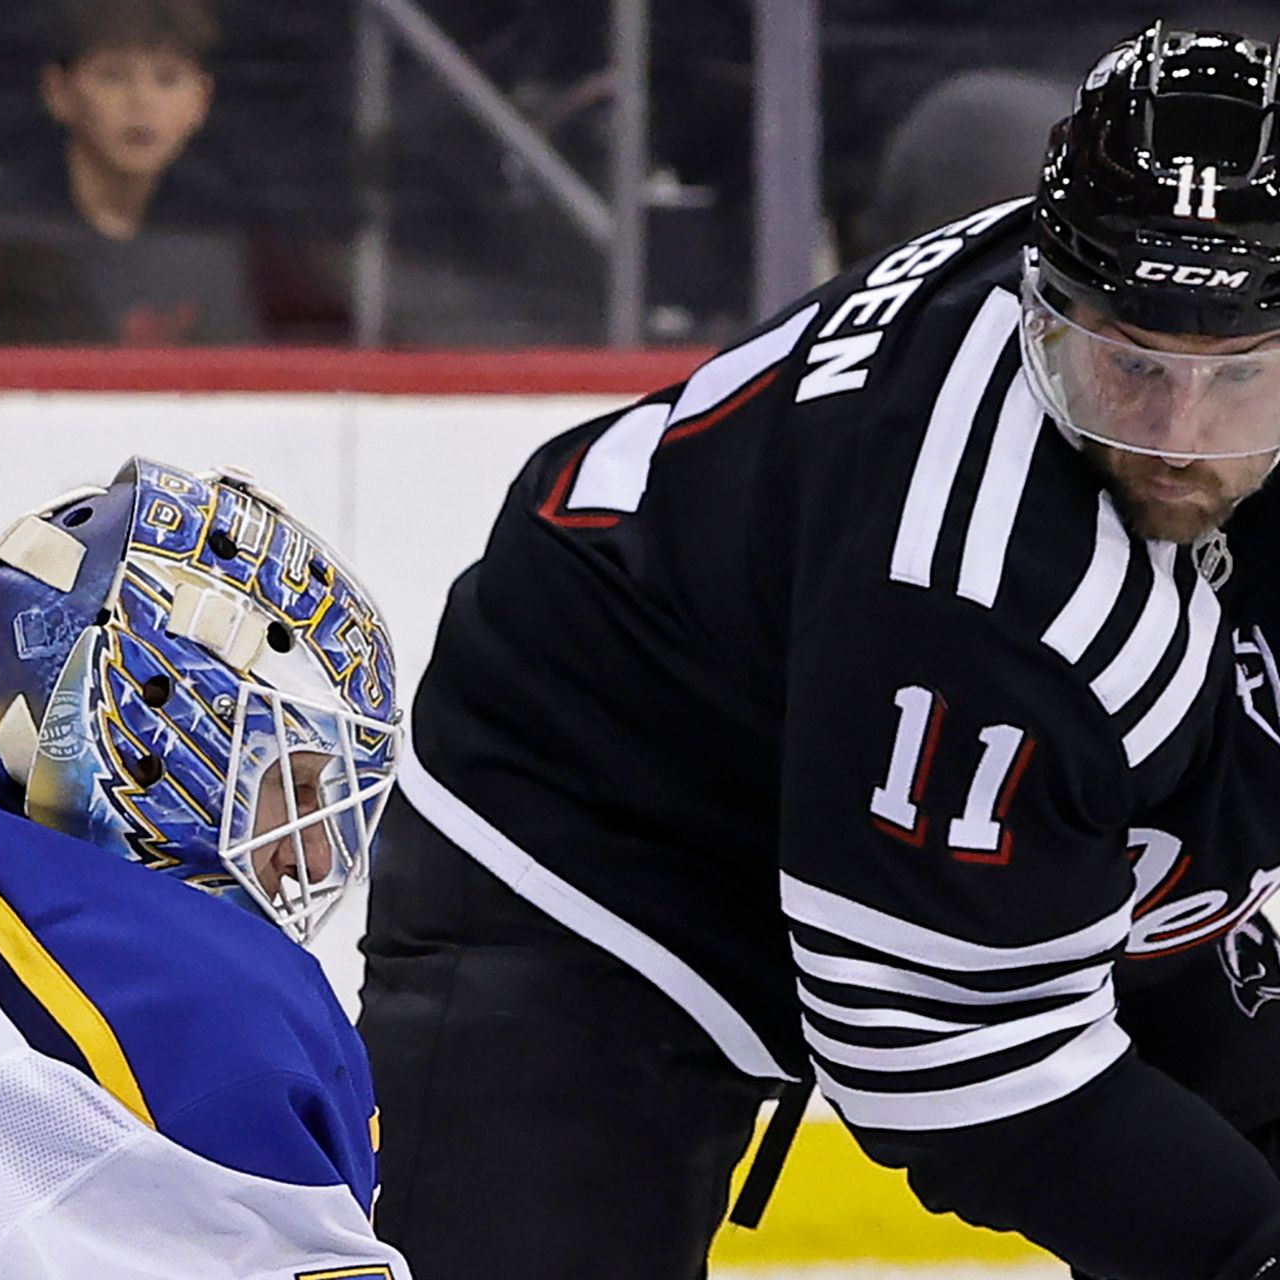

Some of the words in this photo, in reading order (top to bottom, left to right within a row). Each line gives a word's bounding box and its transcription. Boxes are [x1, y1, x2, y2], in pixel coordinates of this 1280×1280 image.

[1172, 164, 1217, 219] 11
[1135, 261, 1249, 288] CCM
[870, 685, 1035, 865] 11
